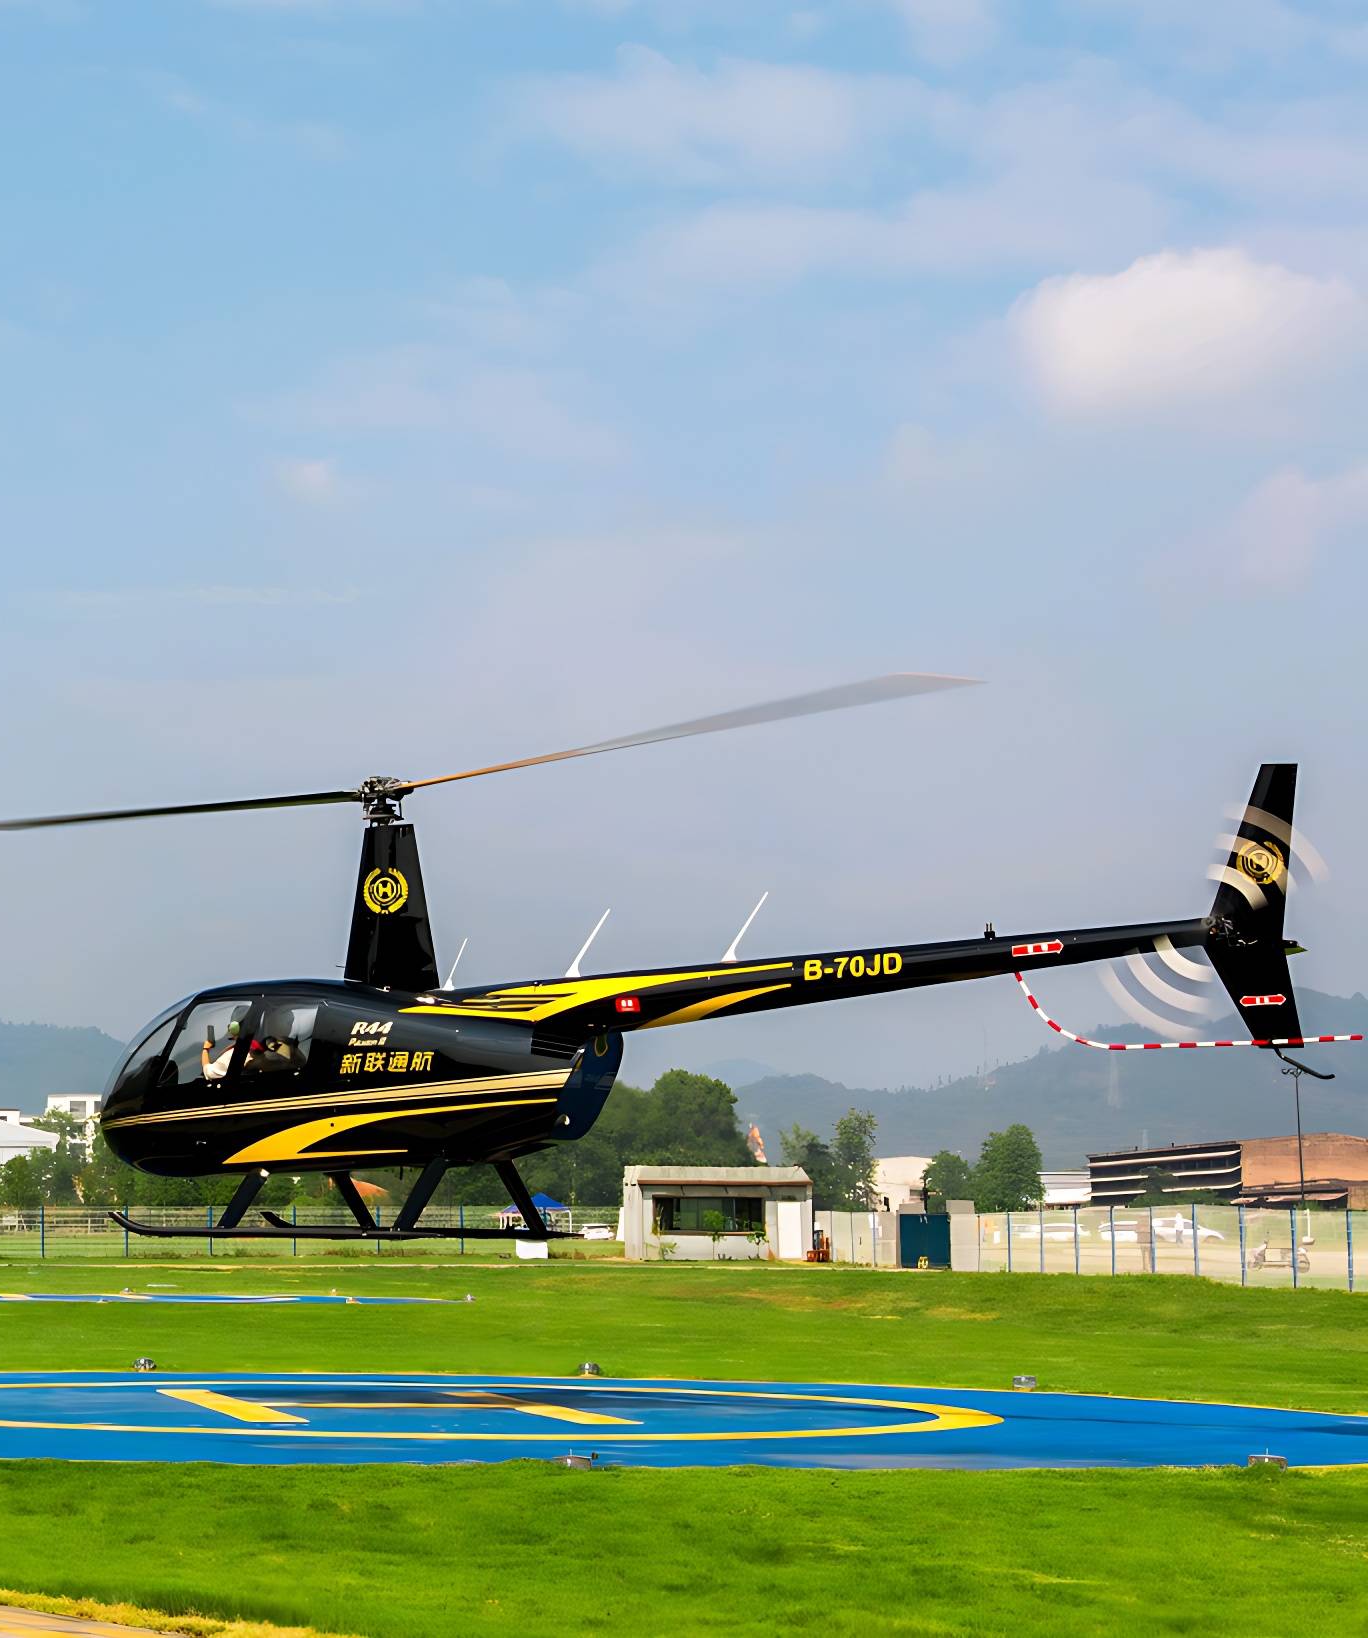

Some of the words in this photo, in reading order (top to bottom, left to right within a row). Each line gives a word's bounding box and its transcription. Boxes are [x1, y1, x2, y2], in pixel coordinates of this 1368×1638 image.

[804, 952, 903, 981] B-70JD
[351, 1021, 393, 1035] R44
[340, 1051, 434, 1074] 新联通航
